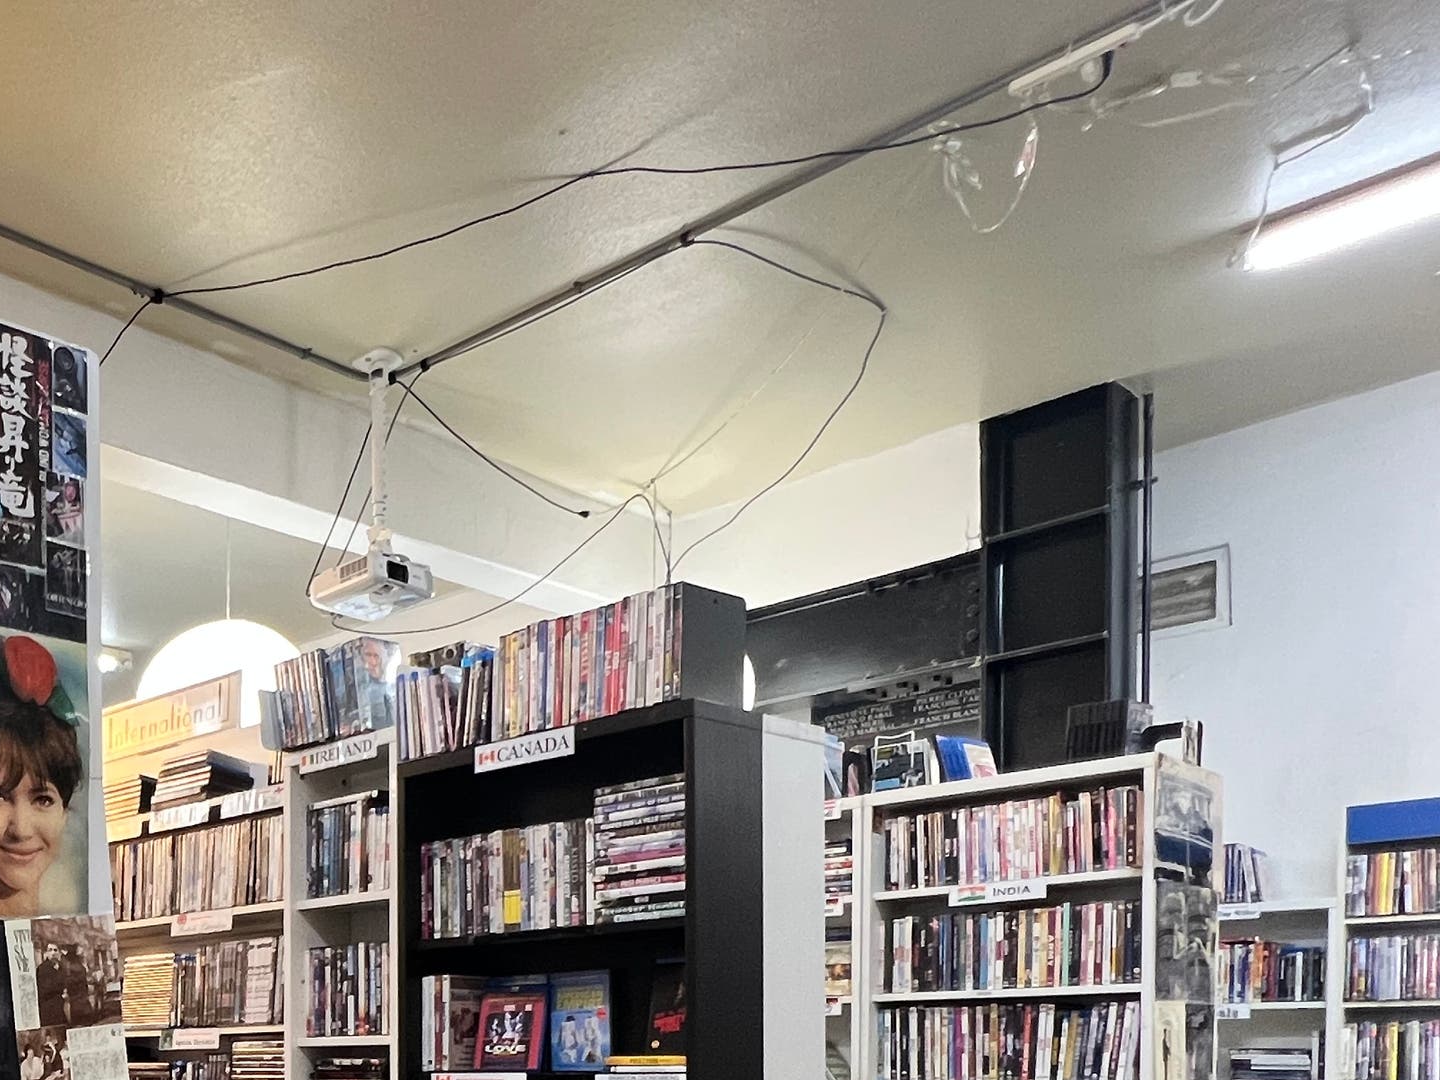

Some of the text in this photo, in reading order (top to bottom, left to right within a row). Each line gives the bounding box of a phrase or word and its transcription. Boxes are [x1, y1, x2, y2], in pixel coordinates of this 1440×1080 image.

[109, 683, 223, 749] International
[497, 735, 570, 763] CANADA
[992, 885, 1032, 896] INDIA
